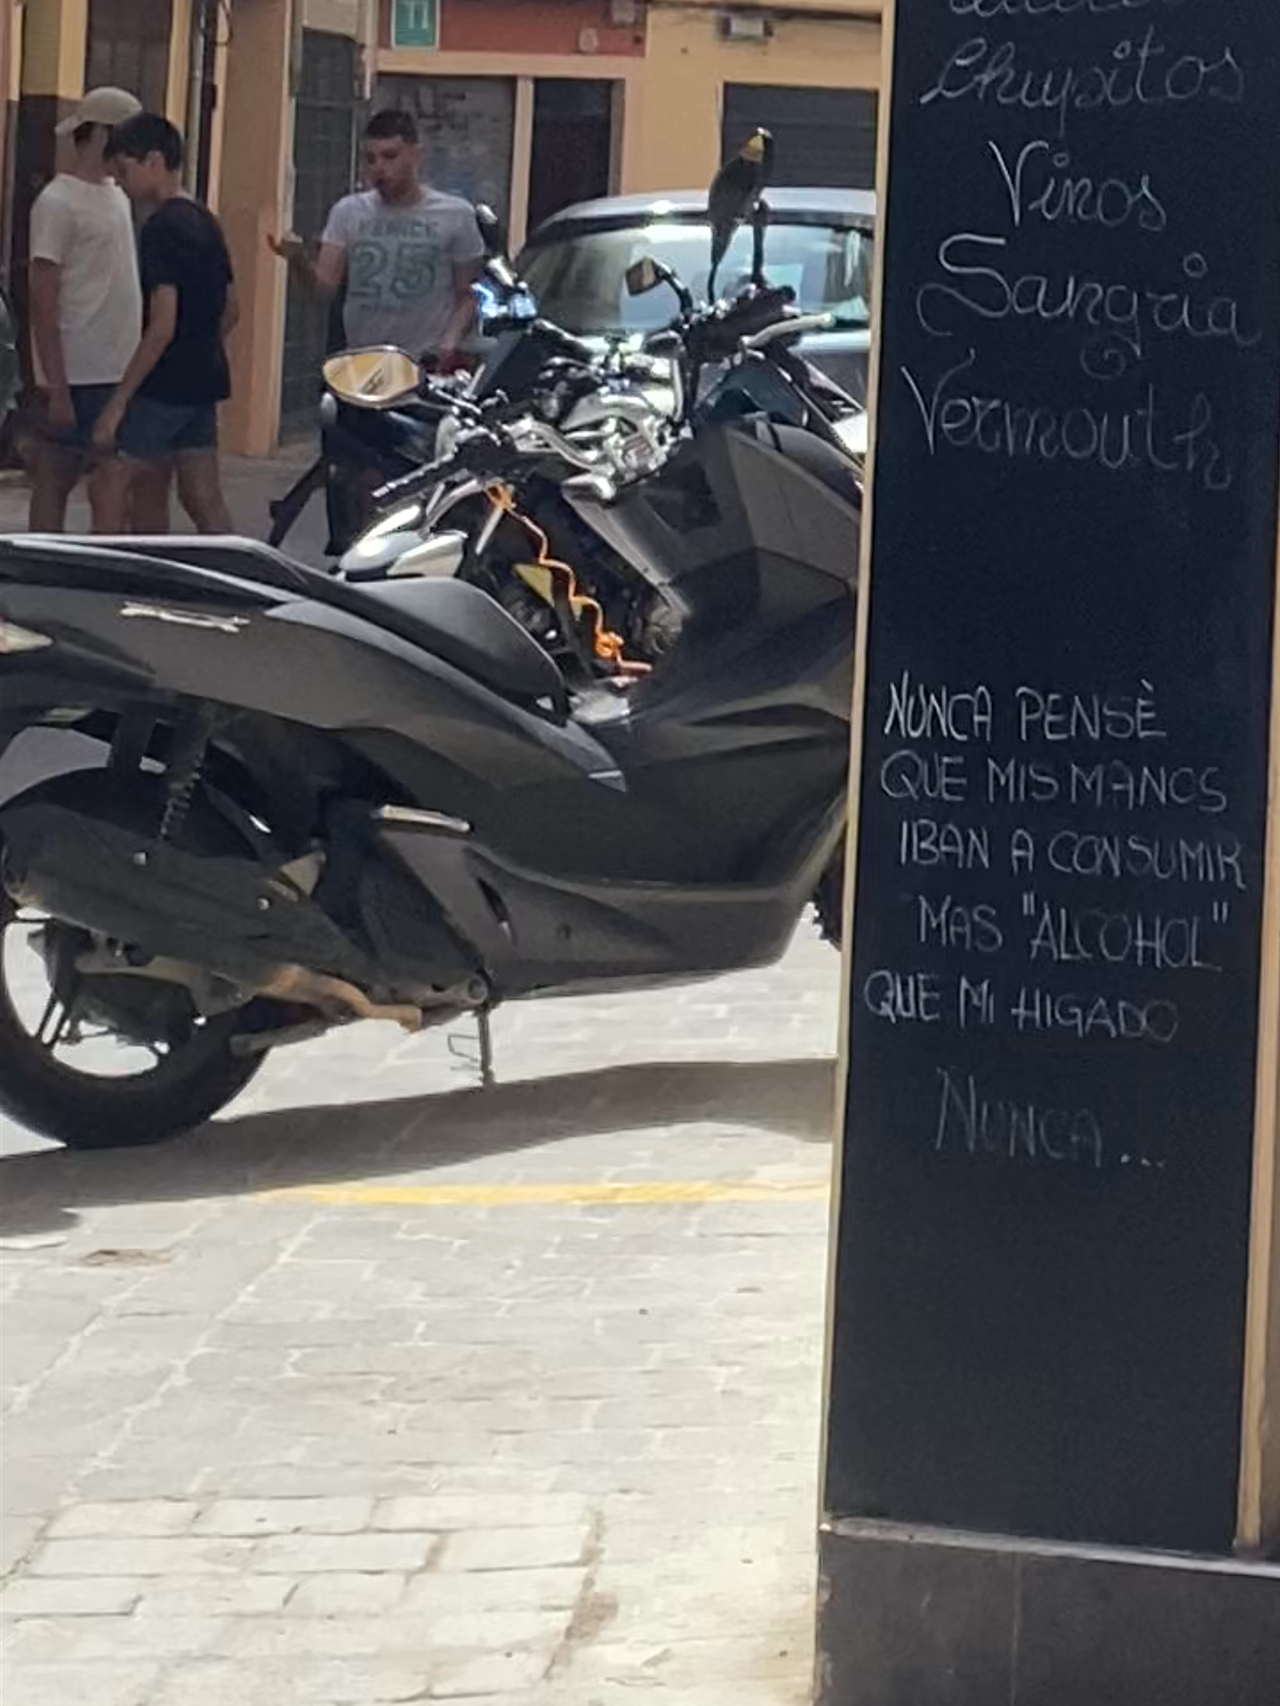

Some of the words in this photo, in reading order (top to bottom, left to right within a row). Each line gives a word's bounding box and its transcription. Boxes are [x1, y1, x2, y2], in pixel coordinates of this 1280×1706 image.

[987, 140, 1167, 231] Vinos
[884, 670, 993, 741] NUNCA
[880, 750, 967, 803] QUE
[987, 757, 1060, 803] MIS
[900, 819, 990, 870] IBAN
[1011, 829, 1034, 875] A
[863, 969, 941, 1024] QUE
[960, 977, 995, 1029] MI
